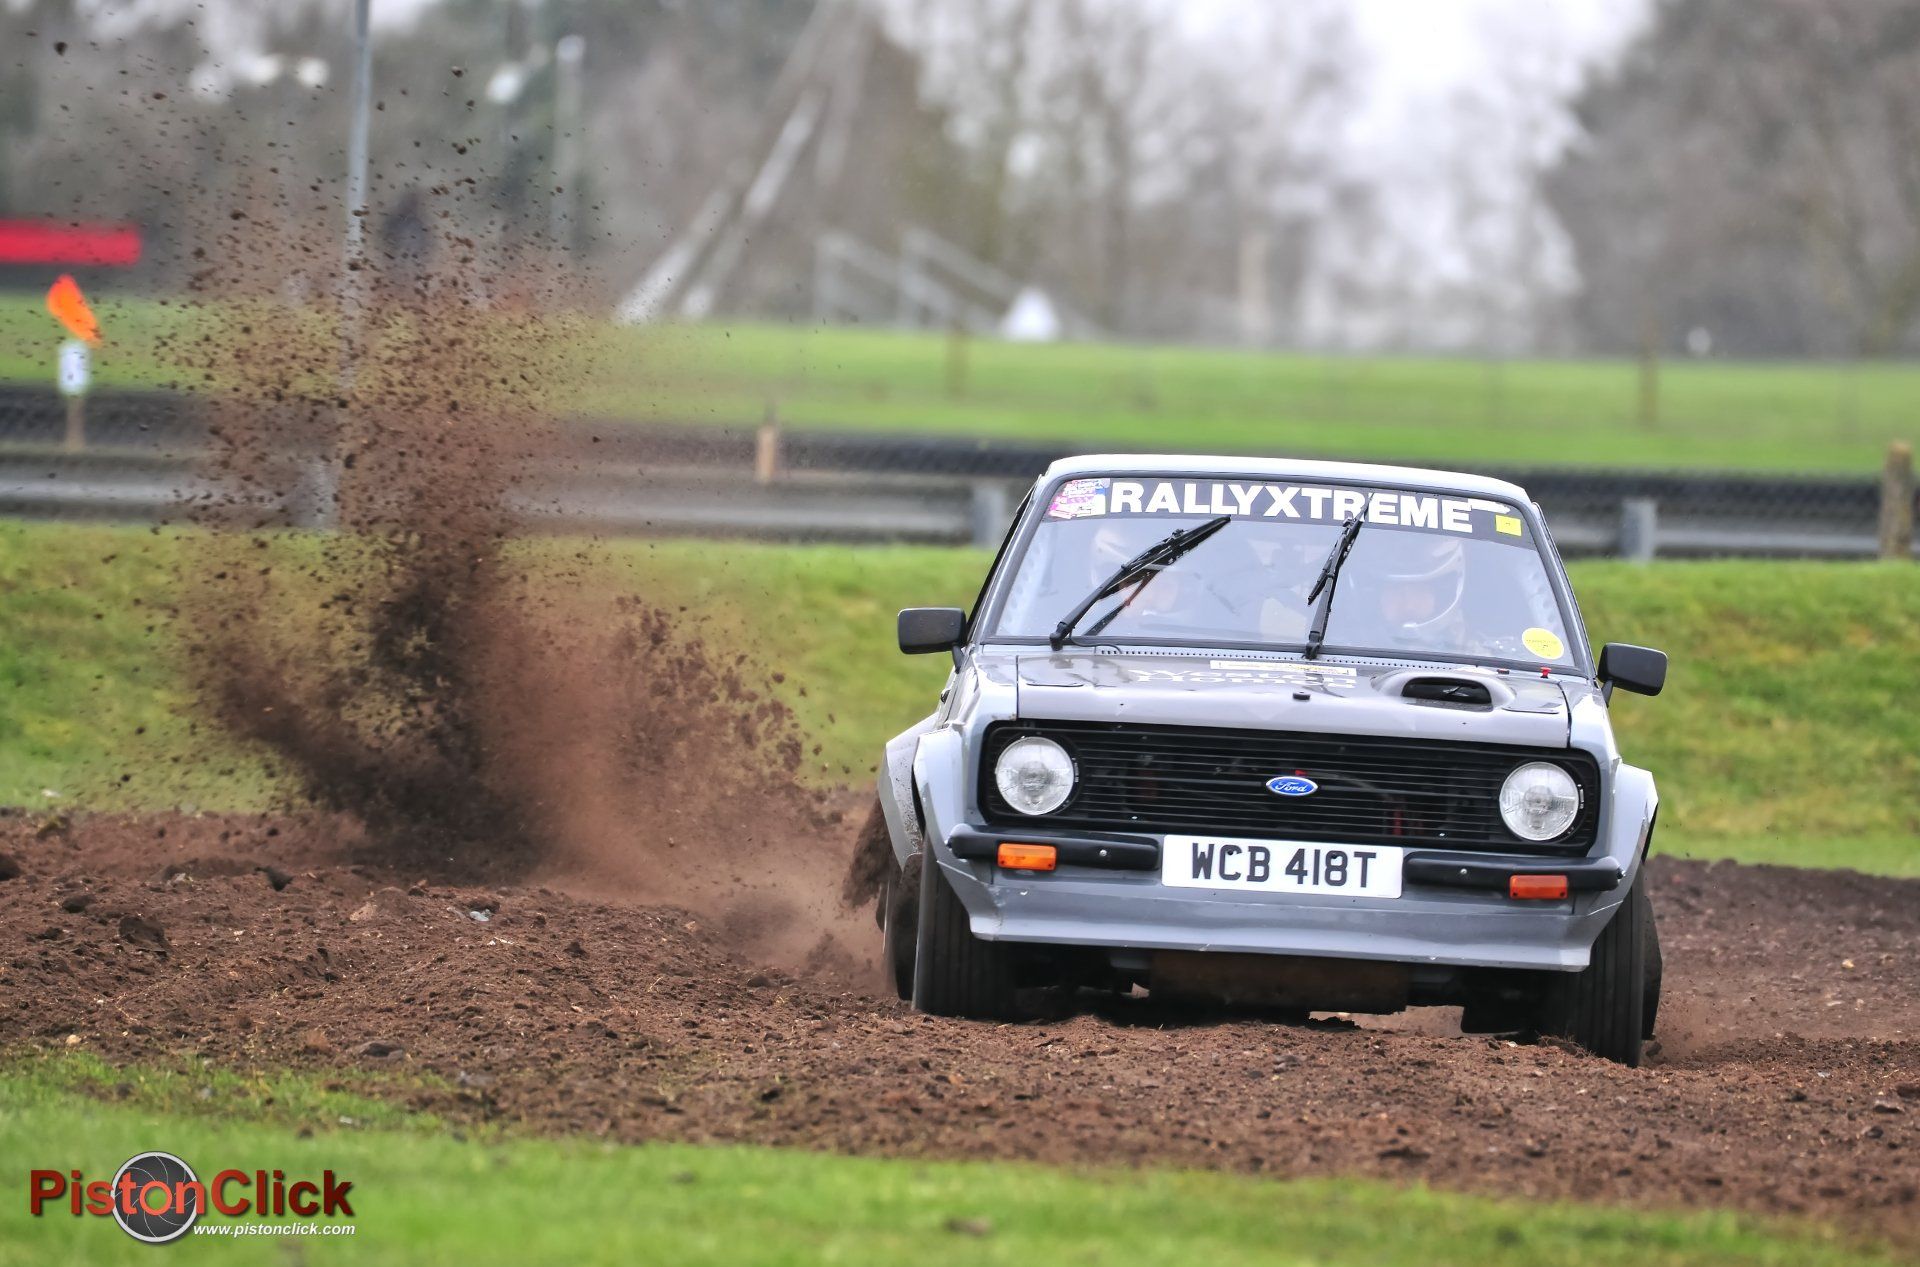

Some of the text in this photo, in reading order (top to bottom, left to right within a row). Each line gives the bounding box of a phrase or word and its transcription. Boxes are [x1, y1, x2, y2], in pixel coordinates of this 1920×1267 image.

[1110, 482, 1473, 533] RALLYXTREME
[1275, 781, 1307, 792] Ford
[1192, 842, 1376, 888] WCB 418T
